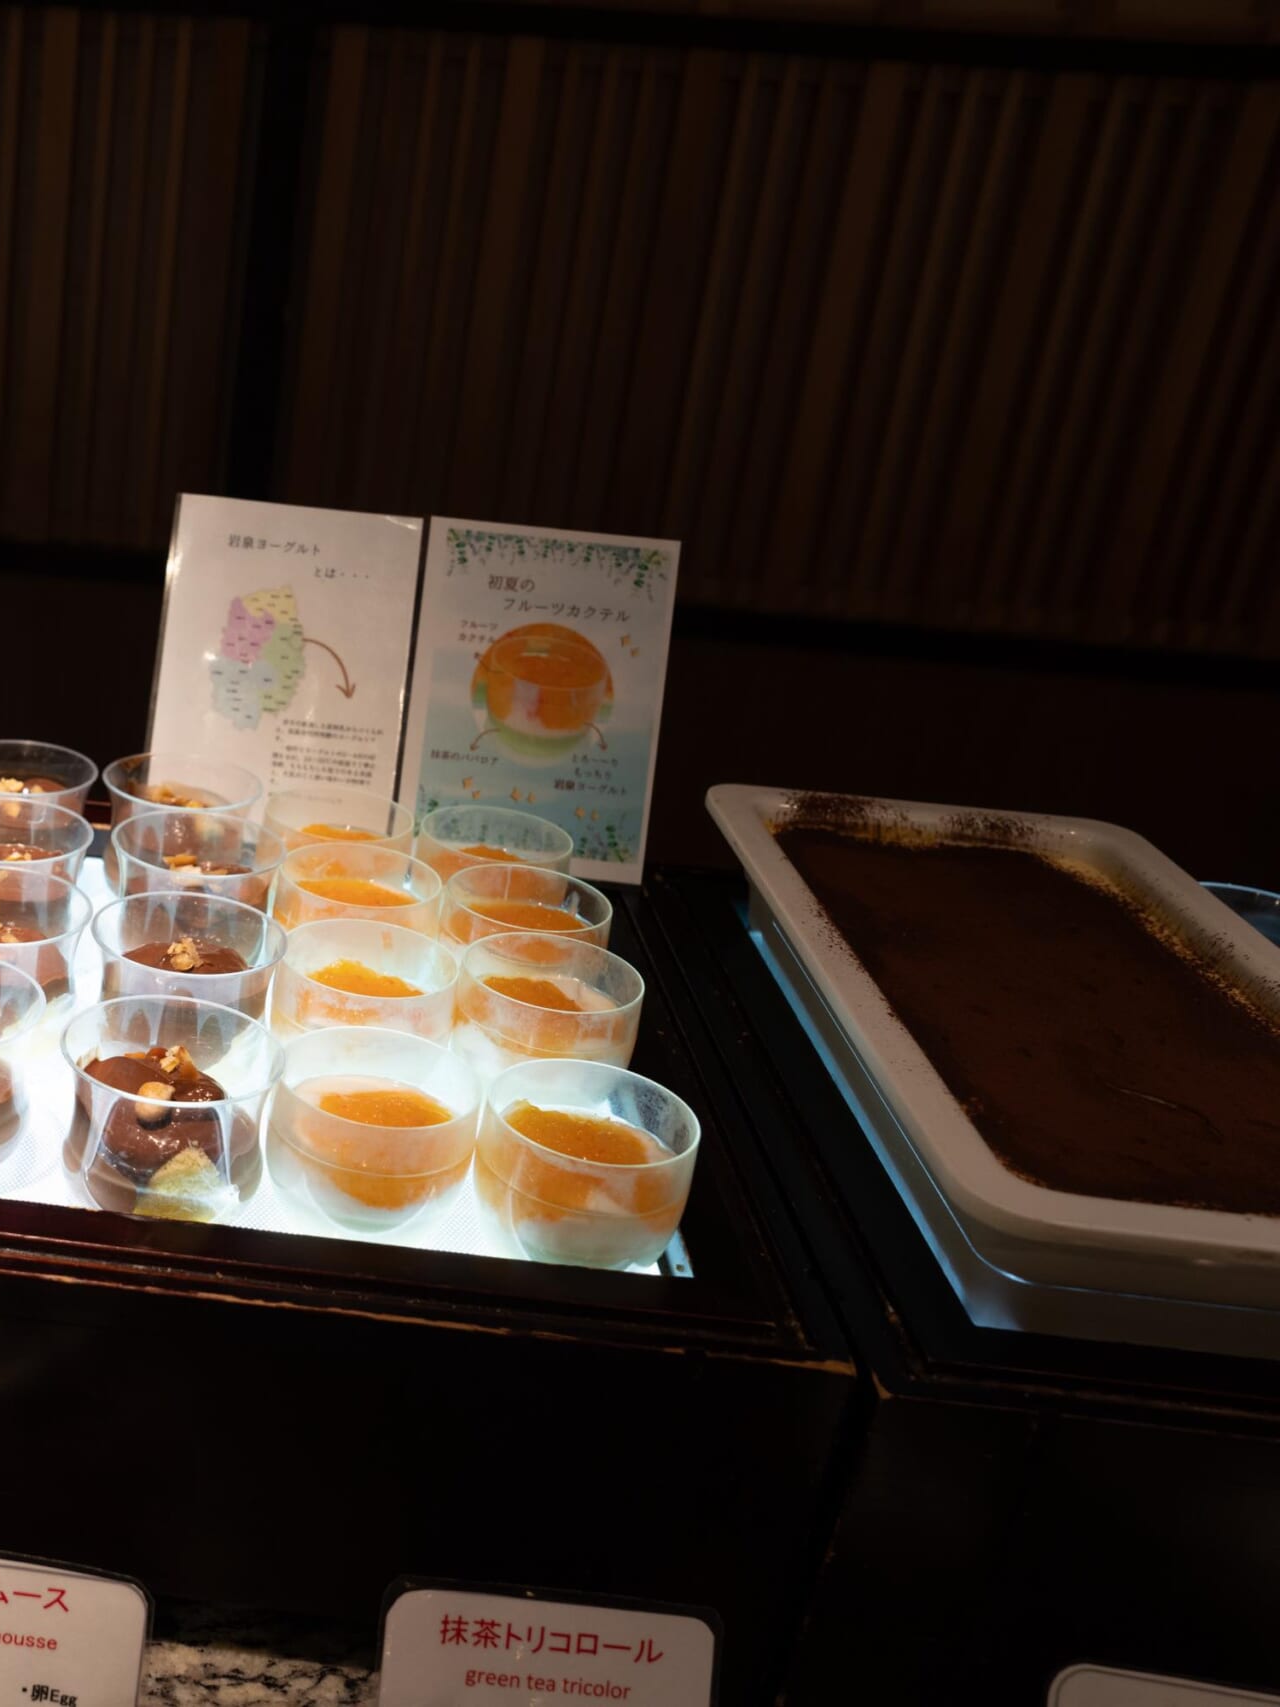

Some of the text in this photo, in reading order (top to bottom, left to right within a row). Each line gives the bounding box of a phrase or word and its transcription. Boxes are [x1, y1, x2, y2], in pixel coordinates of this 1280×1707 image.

[228, 533, 321, 556] 岩泉ヨーグルト
[488, 574, 535, 593] 初夏の
[504, 598, 630, 623] フルーツカクテル
[439, 1614, 664, 1664] 抹茶トリコロール
[464, 1669, 632, 1701] green tea tricolor
